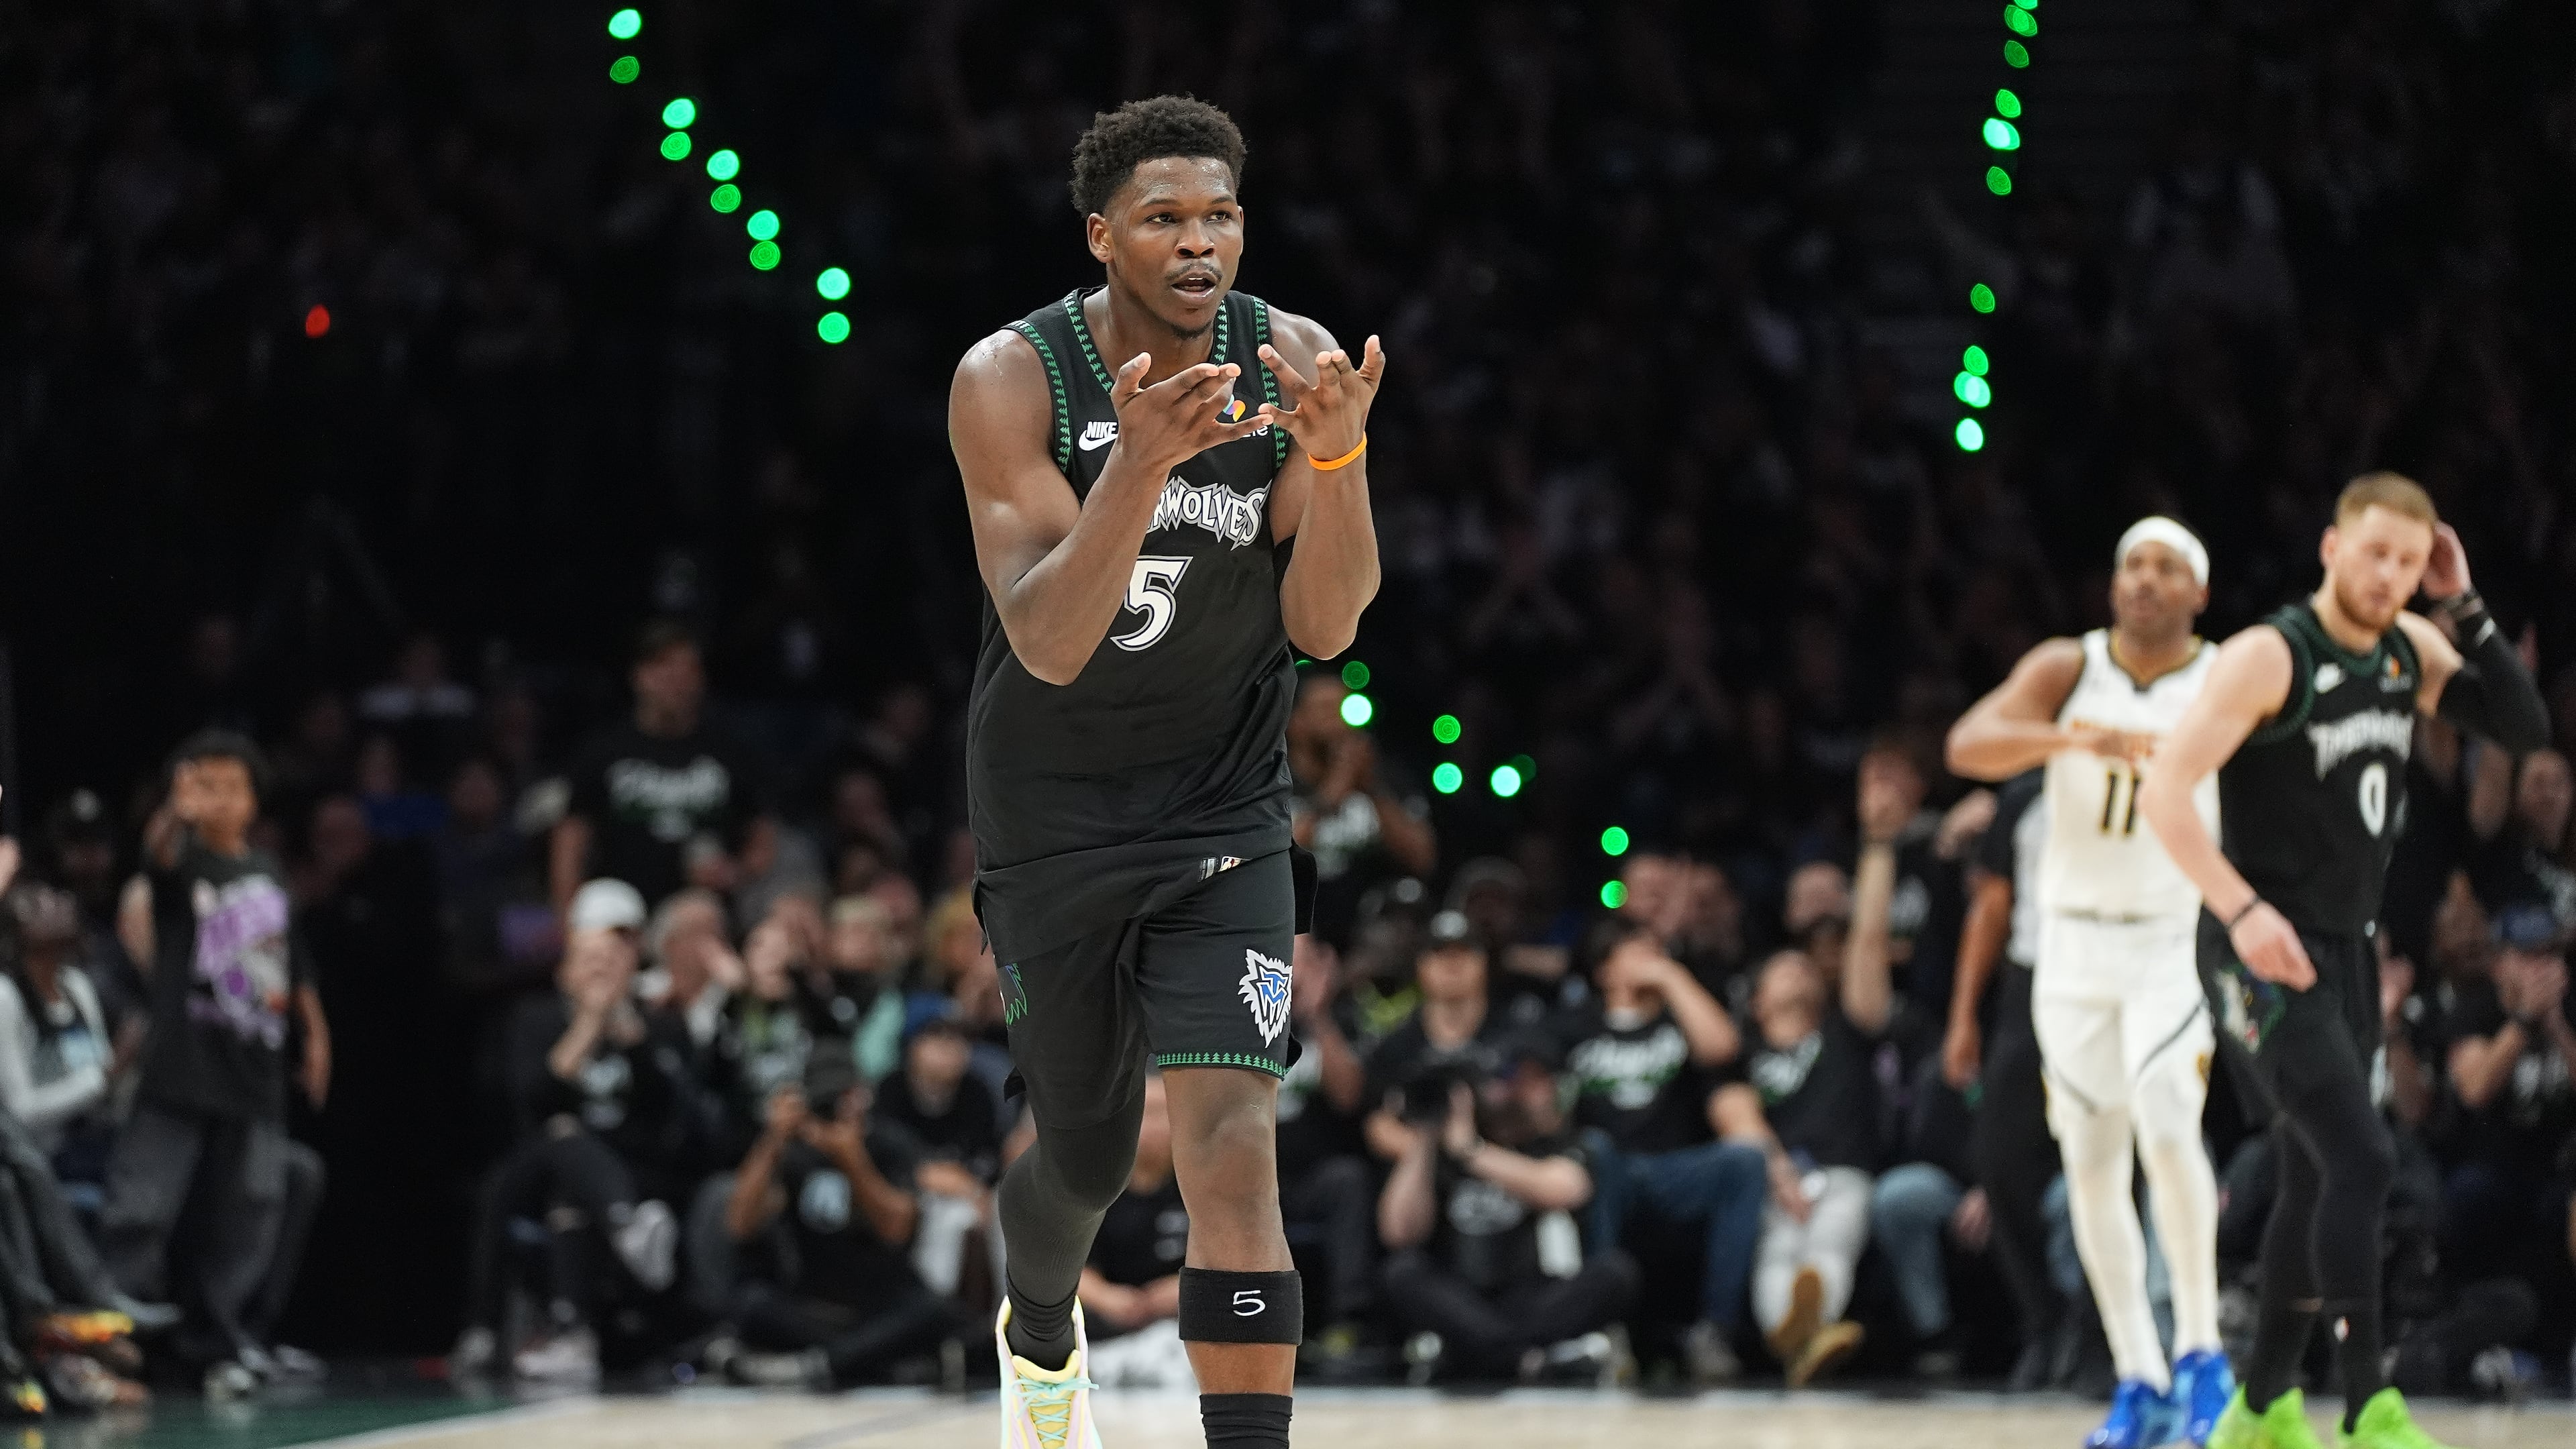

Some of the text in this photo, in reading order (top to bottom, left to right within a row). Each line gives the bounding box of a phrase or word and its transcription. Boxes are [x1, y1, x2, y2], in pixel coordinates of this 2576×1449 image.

[1086, 421, 1118, 438] NIKE
[1146, 475, 1273, 551] RWOLVES
[1110, 555, 1193, 651] 5
[2100, 770, 2143, 835] 11
[2358, 761, 2388, 837] 0
[1233, 1289, 1266, 1316] 5
